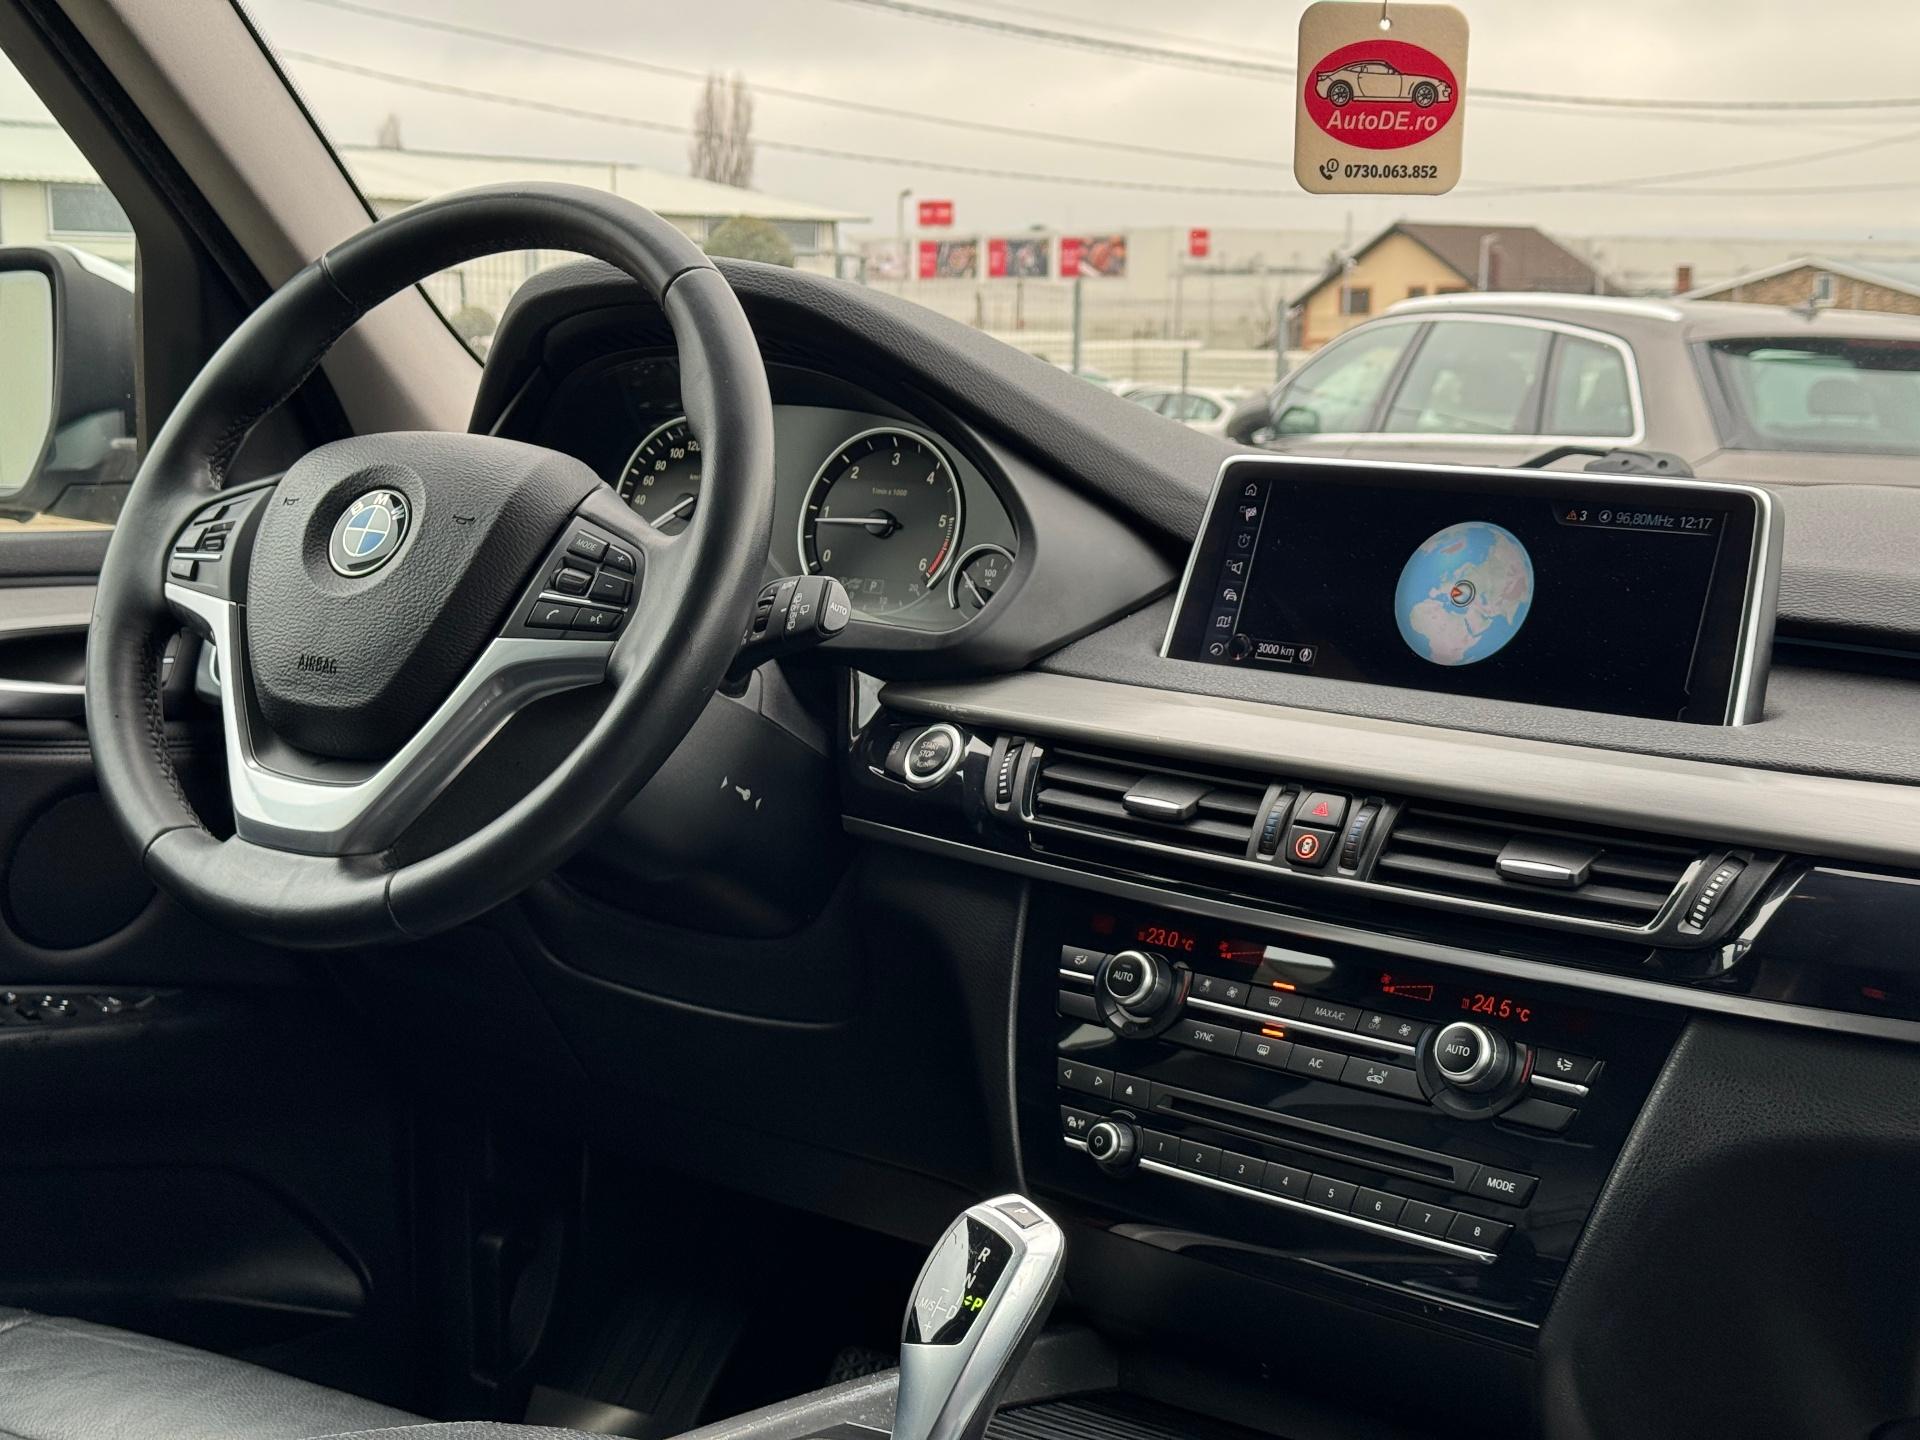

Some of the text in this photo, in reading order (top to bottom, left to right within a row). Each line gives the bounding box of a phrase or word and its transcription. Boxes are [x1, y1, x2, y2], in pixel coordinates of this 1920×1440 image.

[1326, 110, 1438, 131] AutoDE.ro
[1344, 164, 1438, 179] 0730.063.852
[670, 448, 685, 459] 100
[891, 452, 901, 466] 3
[655, 460, 667, 471] 80
[850, 466, 860, 480] 2
[926, 471, 936, 485] 4
[643, 475, 655, 486] 60
[893, 488, 908, 497] 1000
[634, 494, 647, 505] 40
[350, 492, 405, 521] BMW
[823, 505, 830, 518] 1
[938, 514, 947, 528] 5
[1579, 510, 1713, 529] 3 96,80MHz 12:17
[576, 538, 598, 551] MODE
[822, 549, 831, 562] 0
[918, 558, 928, 571] 6
[984, 569, 997, 578] 100
[830, 602, 848, 615] AUTO
[1257, 643, 1295, 656] 3000 km
[298, 654, 337, 674] AIRBAG
[919, 750, 935, 758] STOP
[1146, 927, 1178, 948] 23.0
[1113, 970, 1134, 983] AUTO
[1472, 994, 1511, 1018] 24.5
[1194, 1030, 1215, 1043] SYNC
[1445, 1043, 1470, 1057] AUTO
[1308, 1057, 1324, 1069] A/C
[1158, 1142, 1164, 1152] 1
[1195, 1152, 1203, 1163] 2
[1238, 1164, 1245, 1175] 3
[1282, 1176, 1289, 1186] 4
[1486, 1176, 1516, 1194] MODE
[1327, 1188, 1334, 1198] 5
[1375, 1200, 1382, 1211] 6
[1424, 1213, 1431, 1223] 7
[1473, 1226, 1481, 1237] 8
[978, 1247, 991, 1262] R
[965, 1272, 977, 1289] N
[971, 1297, 983, 1311] P
[945, 1305, 958, 1320] D
